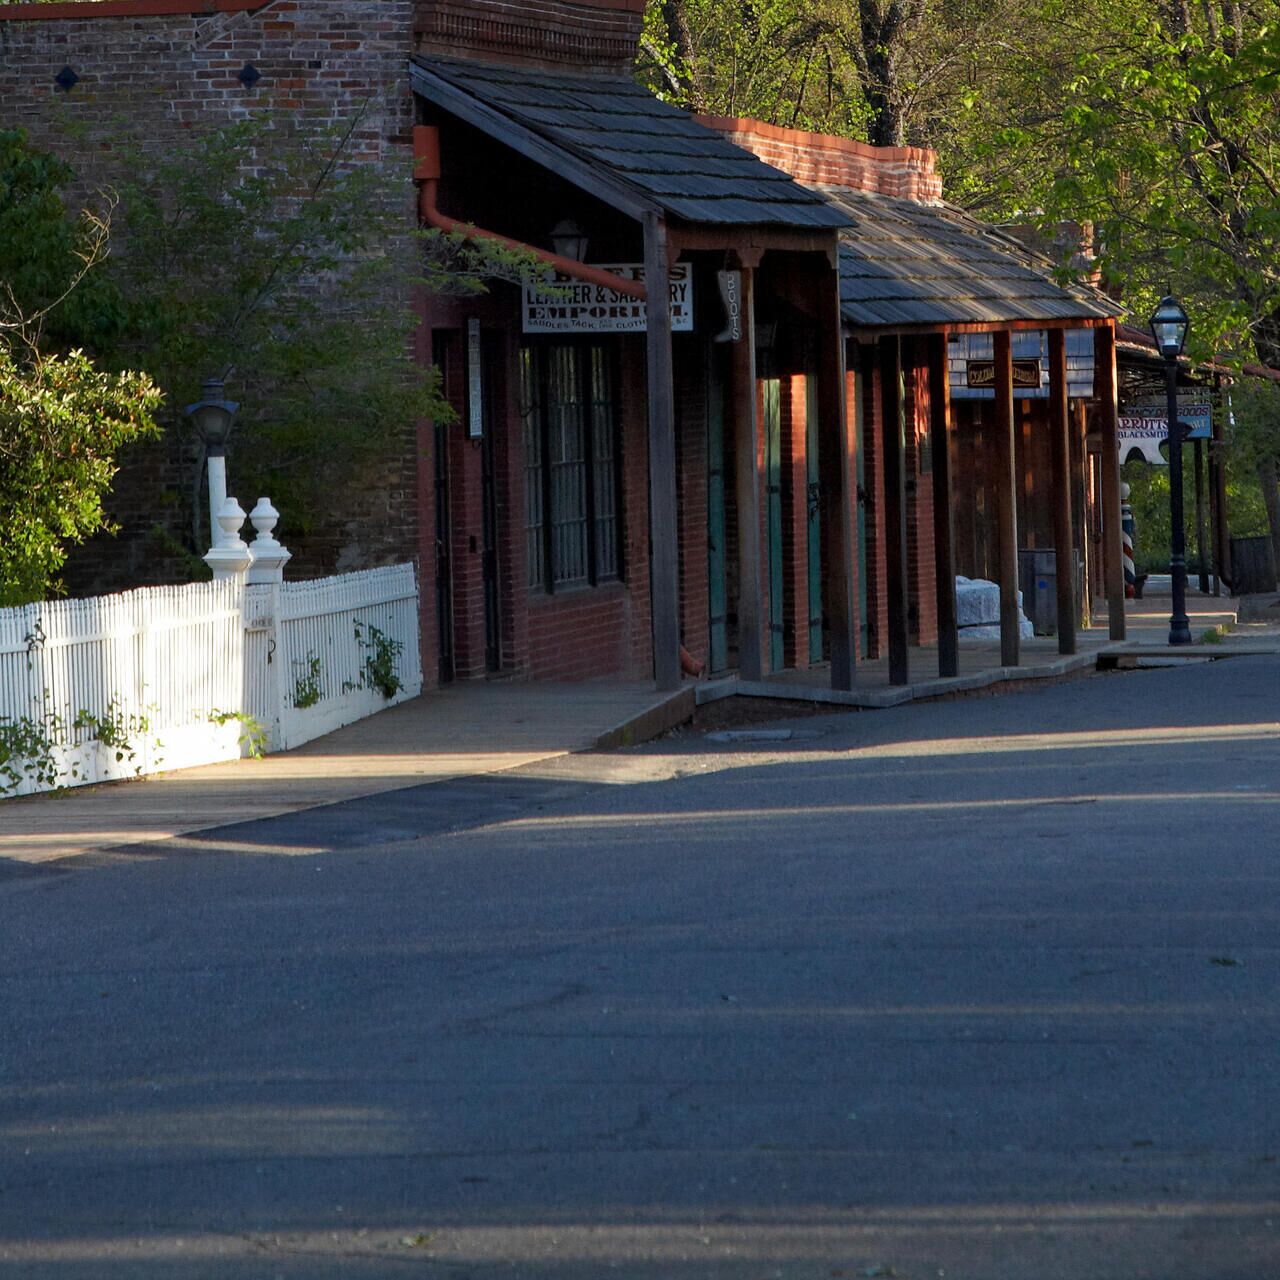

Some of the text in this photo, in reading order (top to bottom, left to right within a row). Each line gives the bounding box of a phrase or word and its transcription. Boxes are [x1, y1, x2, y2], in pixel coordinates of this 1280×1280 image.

[595, 284, 607, 303] &
[528, 304, 688, 320] EMPORIM.
[727, 273, 740, 341] BOOTS
[1176, 407, 1209, 417] GOODS
